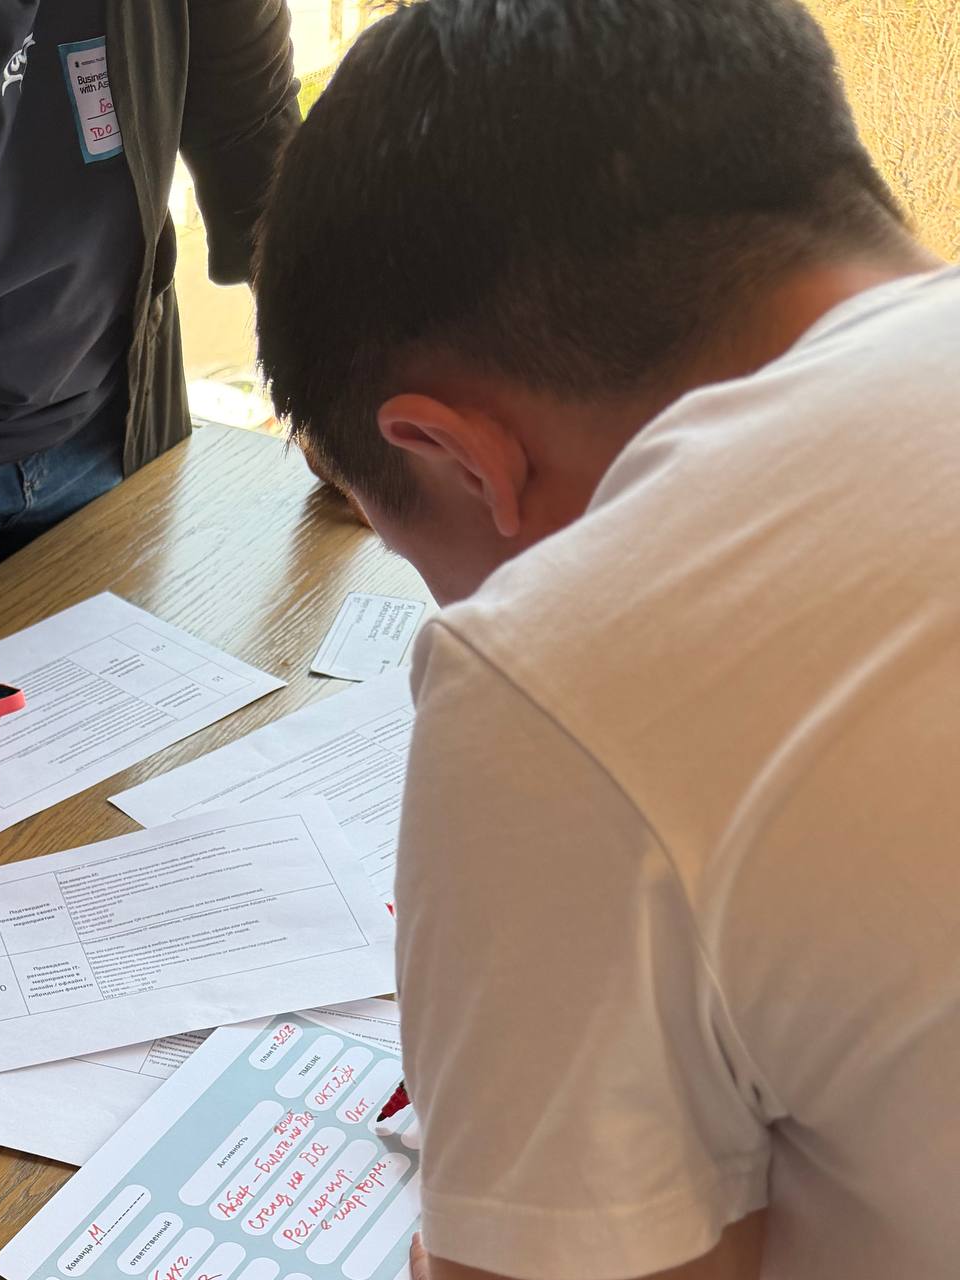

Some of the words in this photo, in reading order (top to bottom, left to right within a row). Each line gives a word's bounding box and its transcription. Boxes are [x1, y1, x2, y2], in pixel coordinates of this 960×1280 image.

[80, 84, 96, 94] with
[260, 1050, 273, 1063] план
[298, 1054, 321, 1077] TIMELINE
[217, 1136, 249, 1169] Активность
[130, 1220, 172, 1266] ответственный
[65, 1244, 94, 1271] Команда
